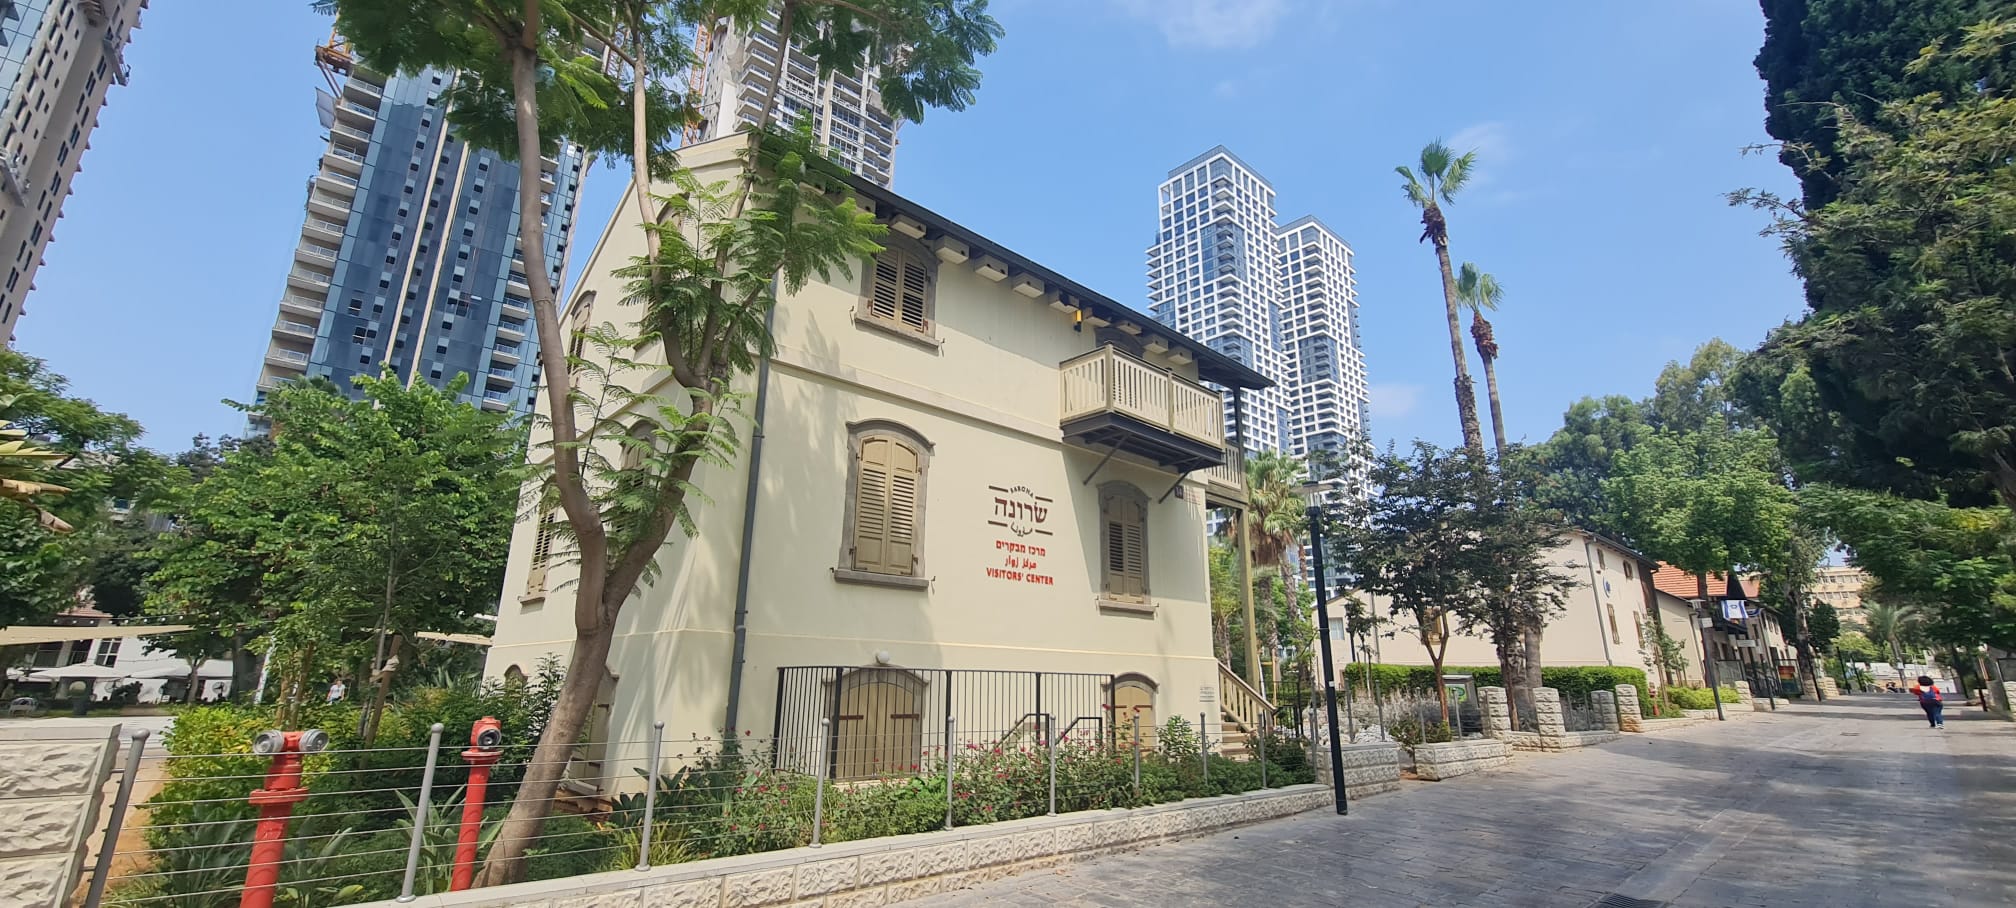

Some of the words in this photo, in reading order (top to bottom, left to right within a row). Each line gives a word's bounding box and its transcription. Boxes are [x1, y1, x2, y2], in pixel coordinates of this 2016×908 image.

[996, 540, 1026, 553] מבקרים
[1028, 546, 1046, 557] מרכז
[1026, 573, 1054, 585] CENTER
